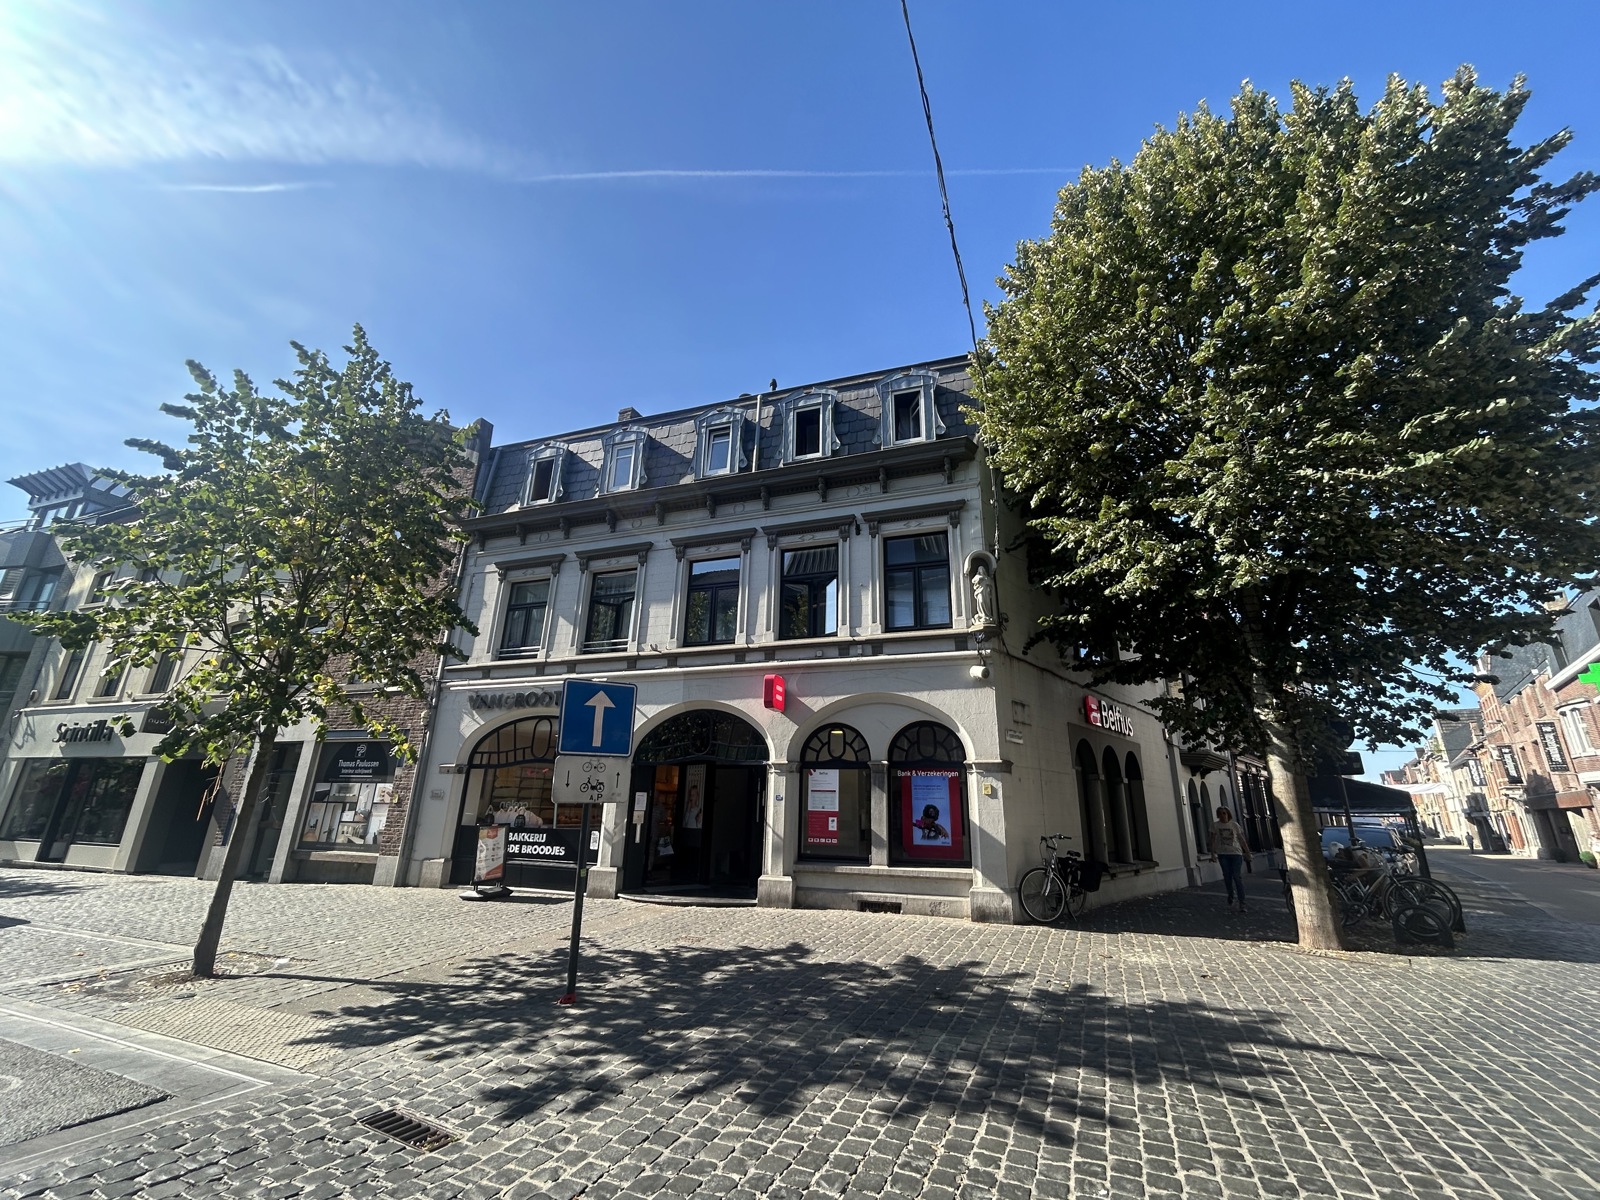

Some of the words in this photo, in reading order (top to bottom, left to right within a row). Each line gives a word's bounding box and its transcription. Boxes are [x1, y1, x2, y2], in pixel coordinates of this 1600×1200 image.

[1101, 700, 1134, 737] Belfius
[52, 720, 115, 742] Scintilla
[917, 770, 959, 778] Verzekeringen
[508, 832, 547, 843] BAKKERIJ
[520, 844, 566, 856] BROODJES
